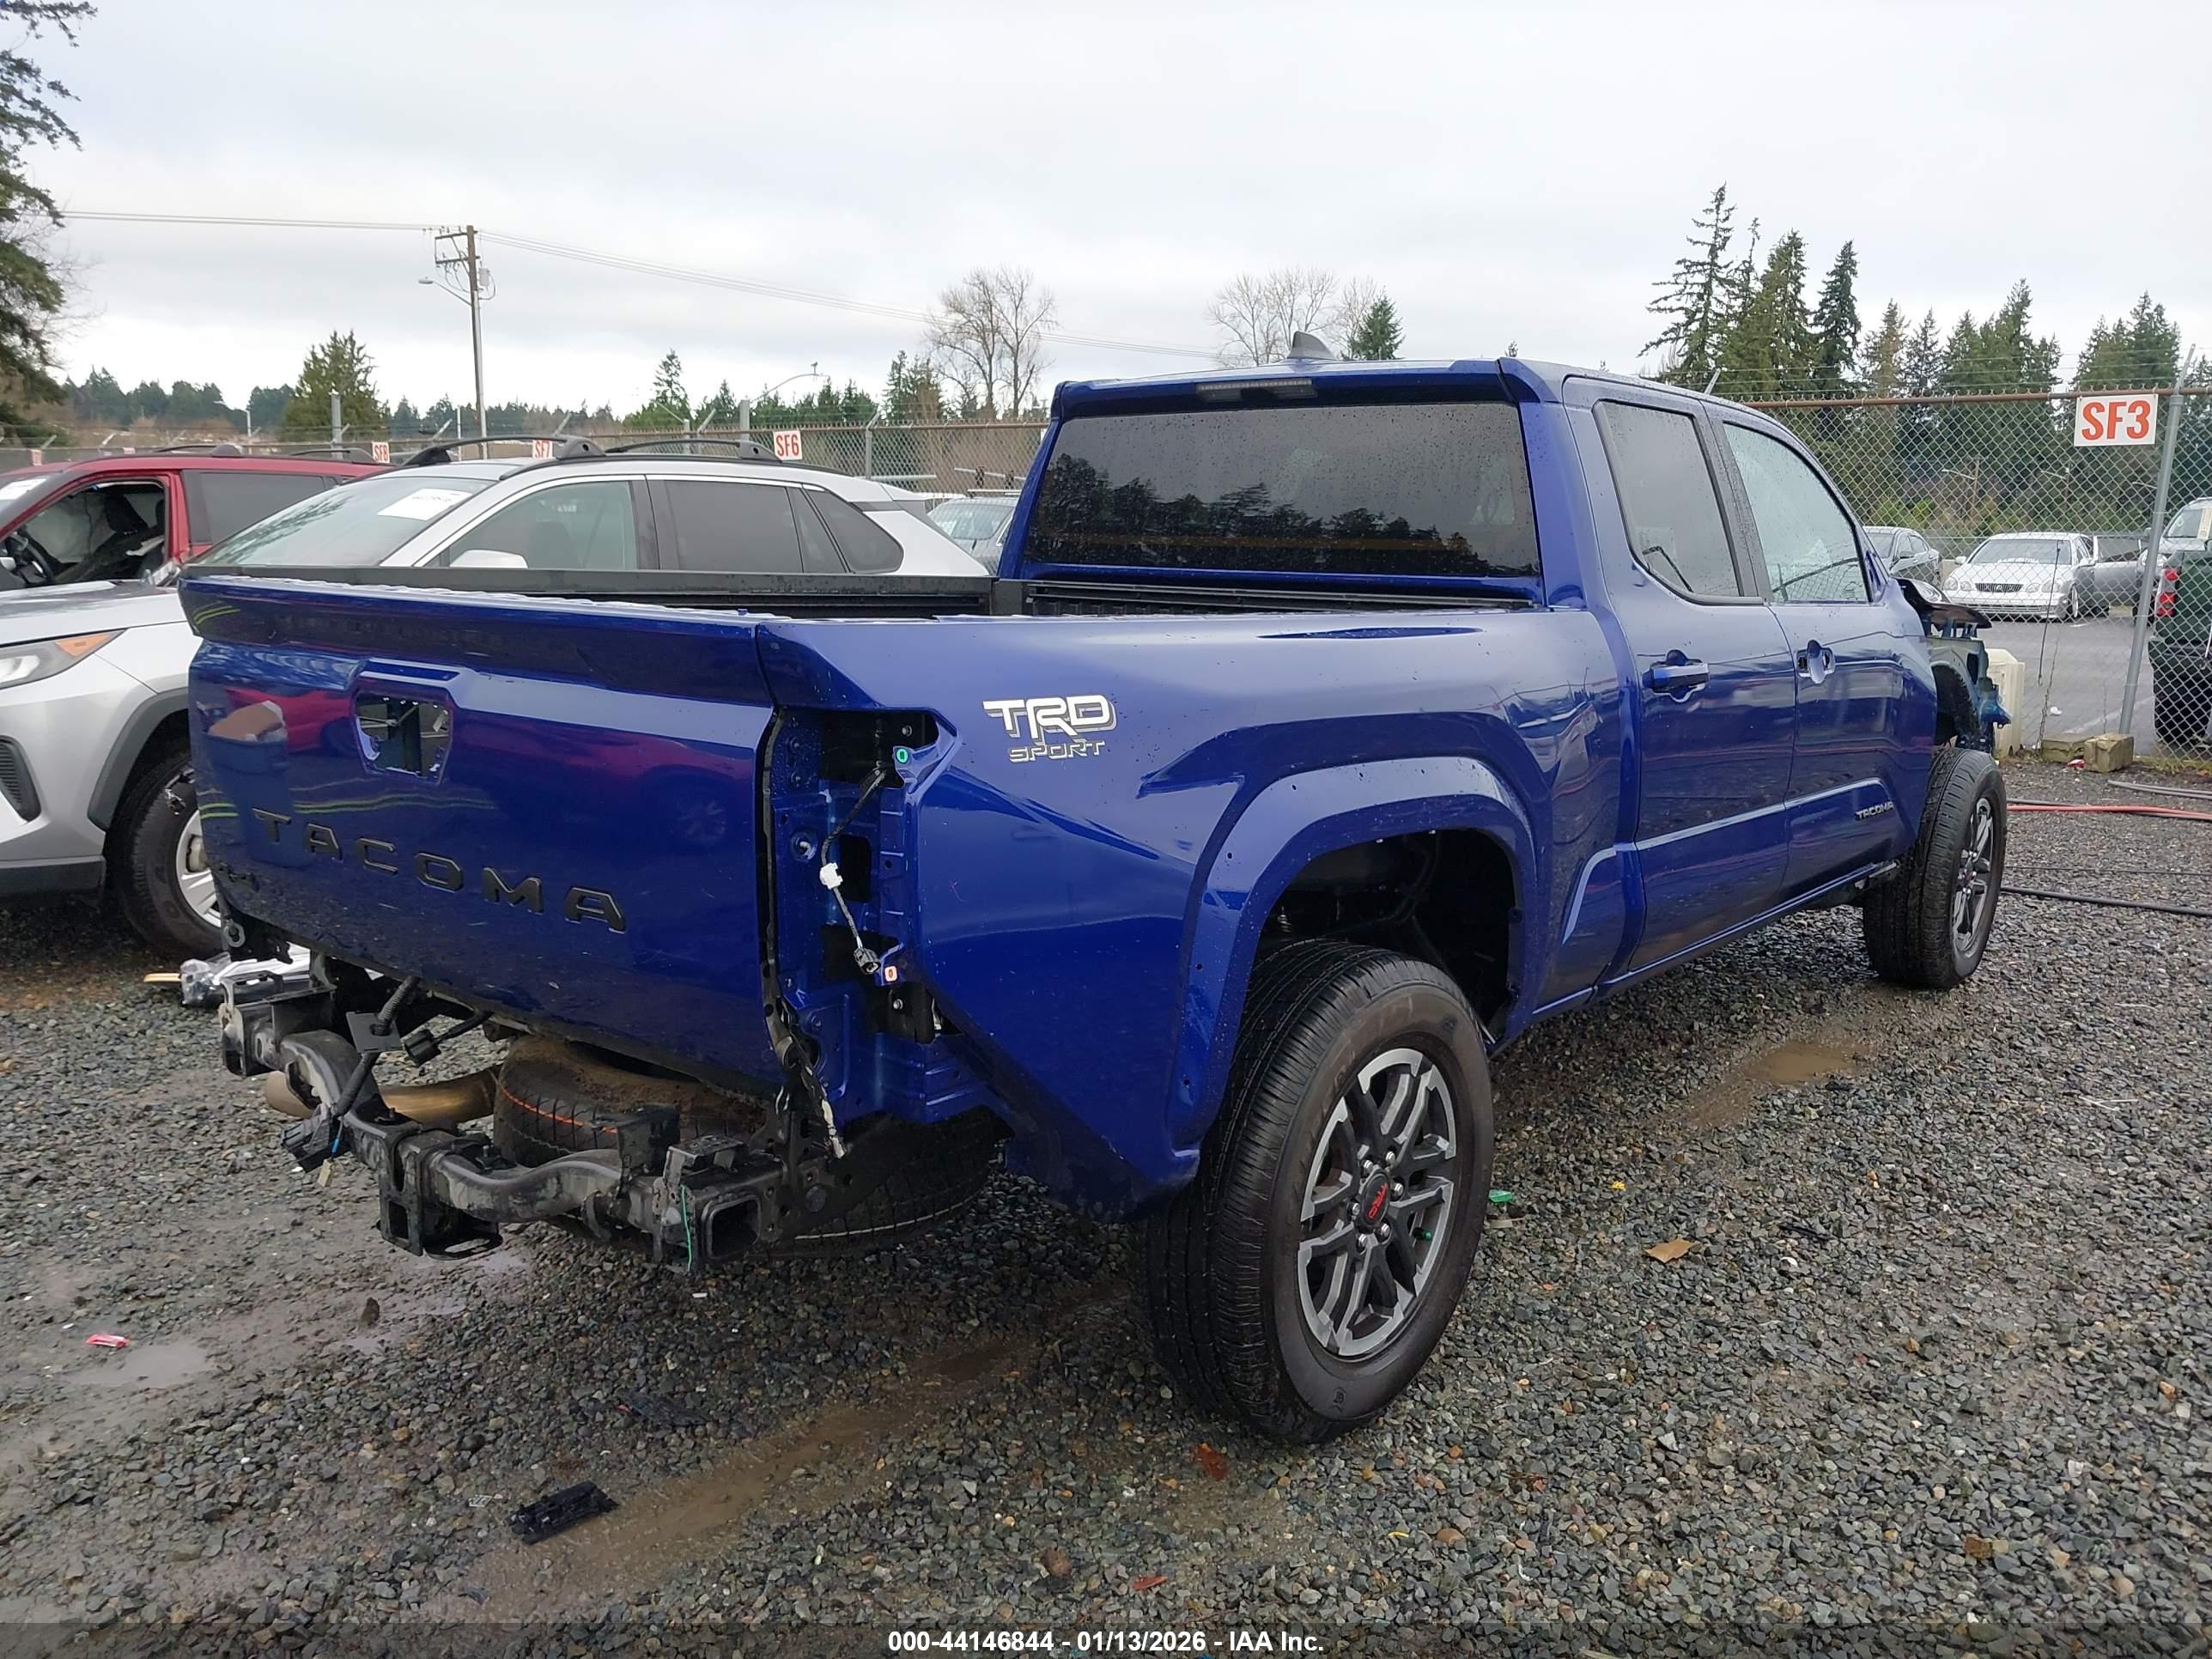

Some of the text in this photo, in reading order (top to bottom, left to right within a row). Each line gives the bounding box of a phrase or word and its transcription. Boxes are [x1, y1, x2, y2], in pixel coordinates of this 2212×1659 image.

[2081, 400, 2150, 441] SF3
[374, 444, 388, 461] SF8
[535, 439, 550, 458] SF7
[776, 434, 799, 456] SF6
[982, 694, 1116, 745] TRD
[1008, 740, 1105, 763] SPORT
[1854, 800, 1894, 820] TACOMA
[252, 807, 627, 934] TACOMA
[1368, 1182, 1389, 1218] TRD
